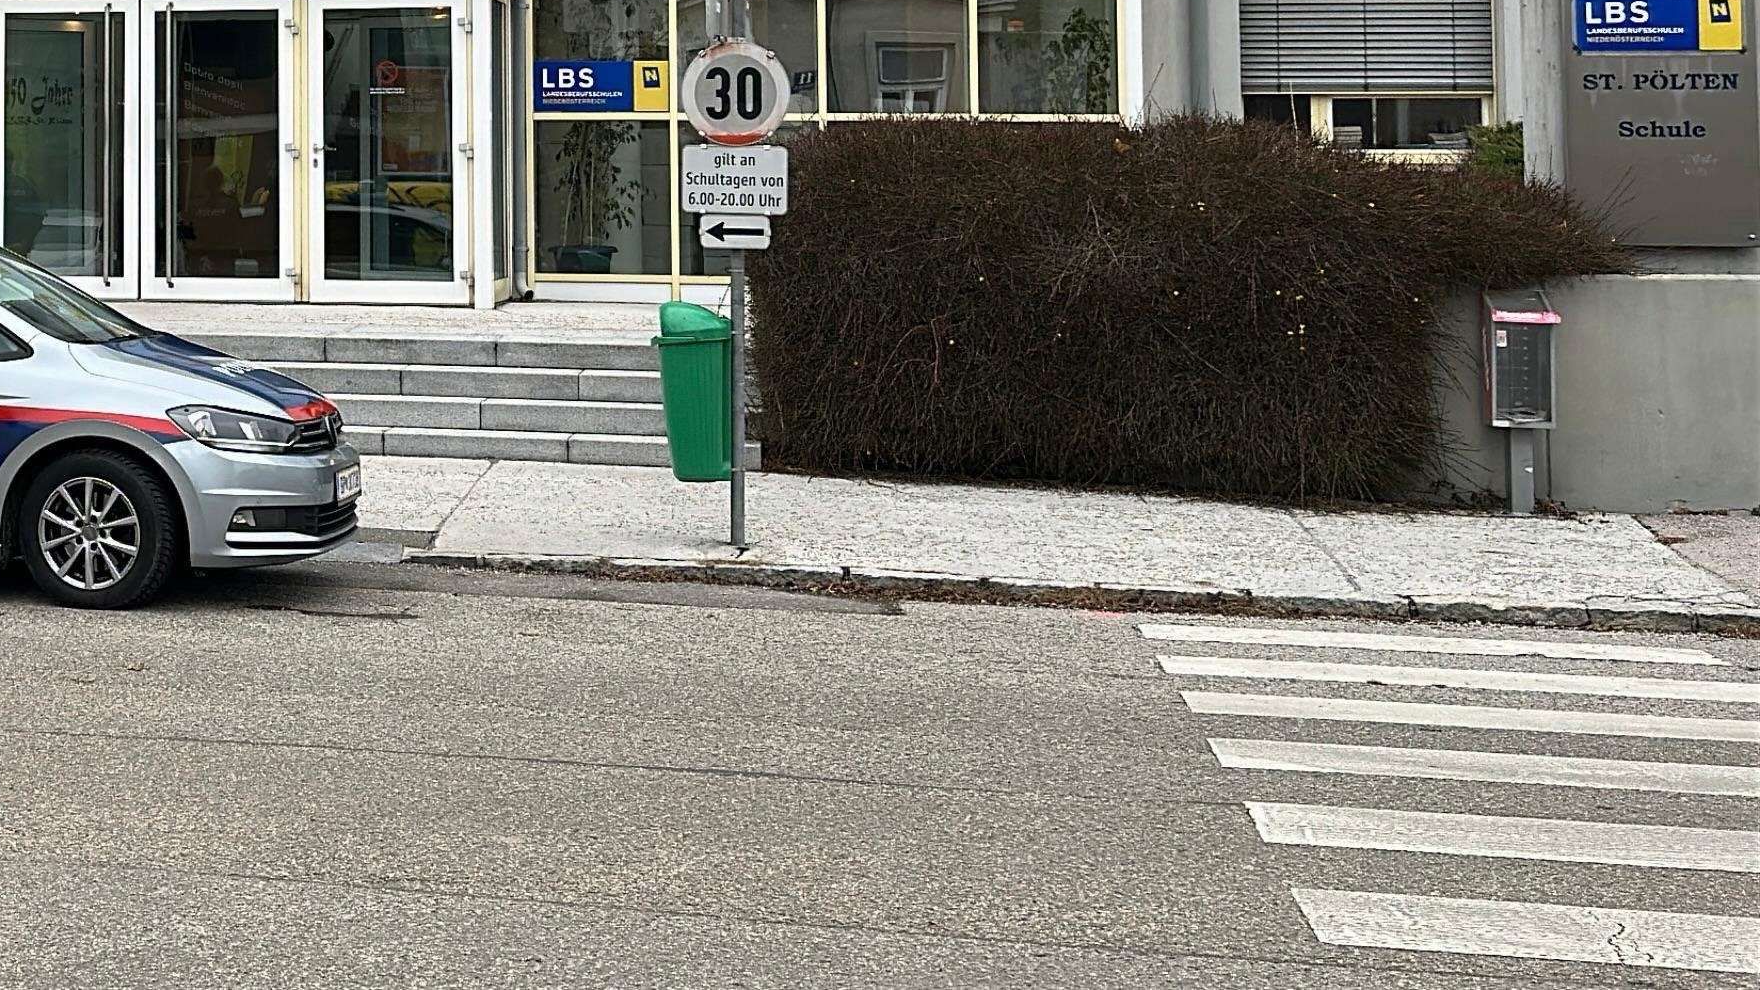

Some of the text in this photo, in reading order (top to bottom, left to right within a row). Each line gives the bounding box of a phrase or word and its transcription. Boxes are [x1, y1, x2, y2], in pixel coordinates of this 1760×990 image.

[1585, 0, 1649, 24] LBS
[542, 67, 594, 88] LBS
[1583, 70, 1739, 90] ST. PÖLTEN
[705, 66, 763, 120] 30
[1618, 120, 1706, 138] Schule
[714, 152, 756, 168] gilt an
[686, 172, 784, 189] Schultagen von
[688, 192, 782, 207] 6.00-20.00 Uhr
